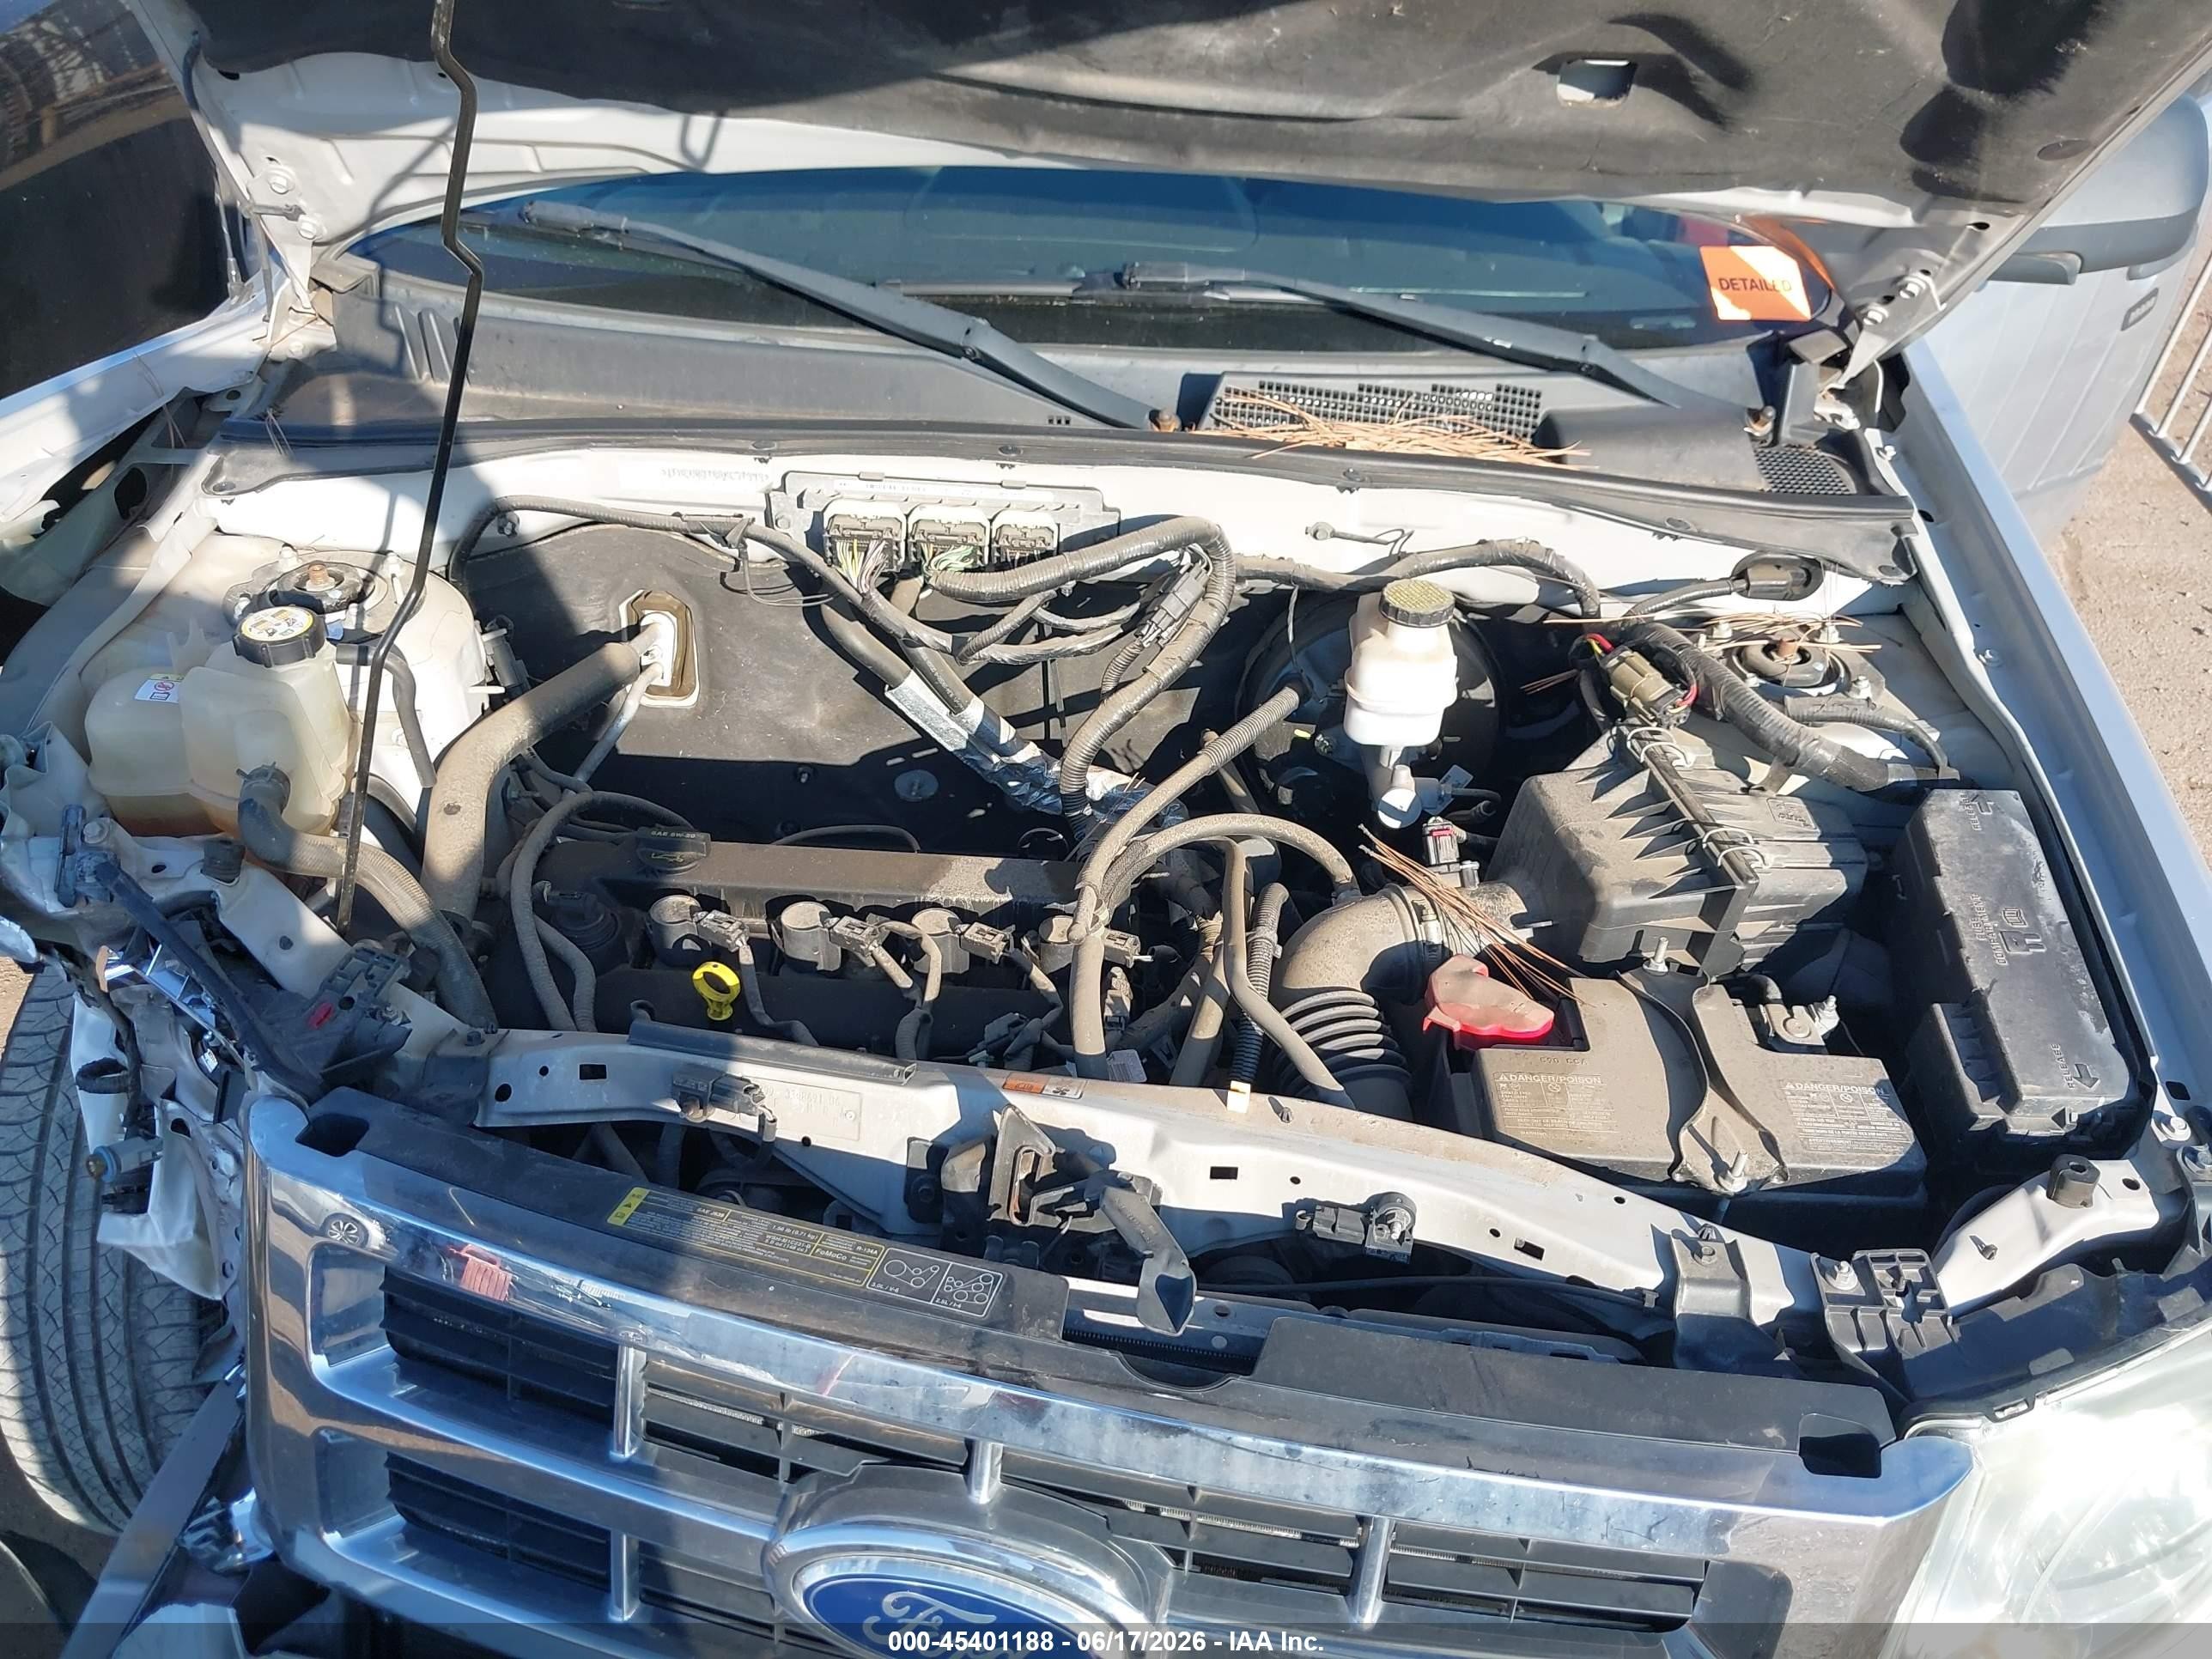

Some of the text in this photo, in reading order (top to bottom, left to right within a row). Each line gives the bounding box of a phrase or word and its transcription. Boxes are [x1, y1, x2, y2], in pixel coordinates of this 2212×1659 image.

[2050, 1043, 2075, 1090] RELEASE
[1510, 1073, 1602, 1085] DANGER/POISON
[1794, 1083, 1884, 1095] DANGER/POISON
[815, 1248, 848, 1261] FoMoCo
